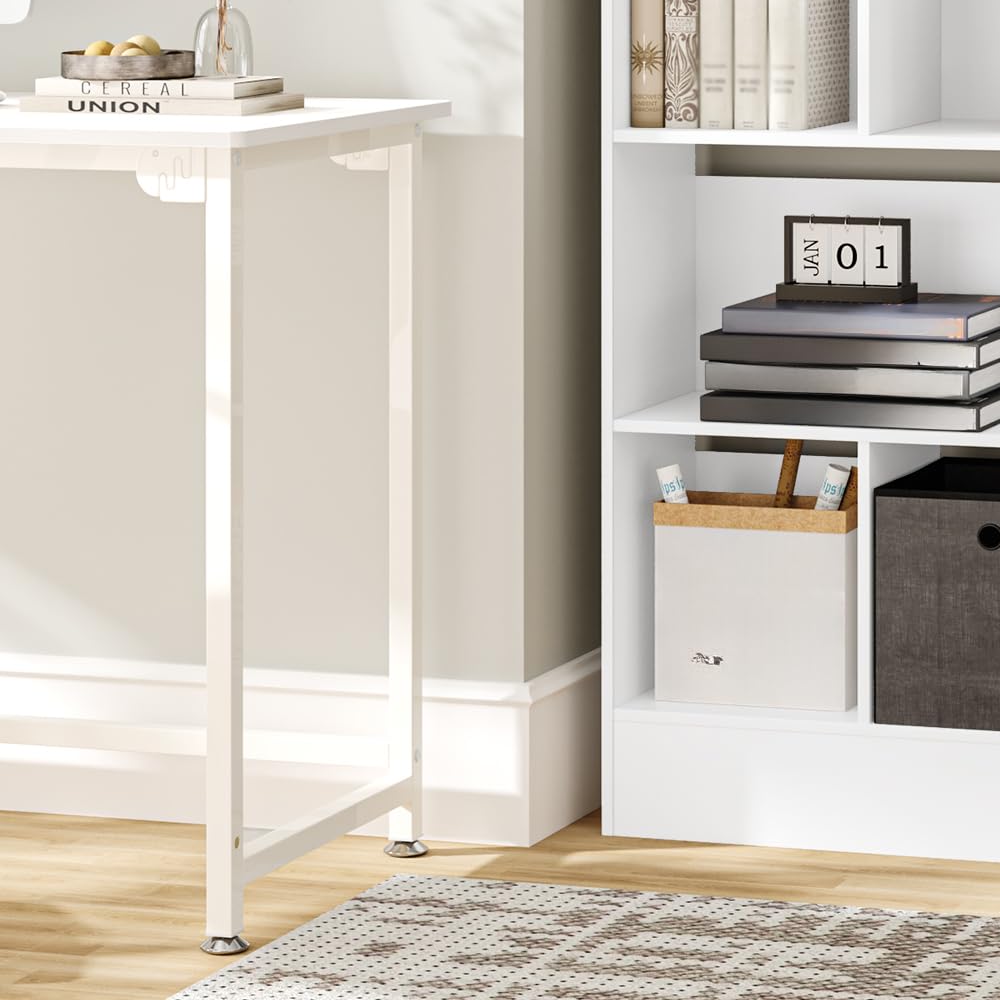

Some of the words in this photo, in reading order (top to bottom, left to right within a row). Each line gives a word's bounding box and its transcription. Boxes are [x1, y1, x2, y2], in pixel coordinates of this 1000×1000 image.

[81, 81, 190, 97] CEREAL
[68, 100, 161, 114] UNION
[804, 239, 819, 277] JAN
